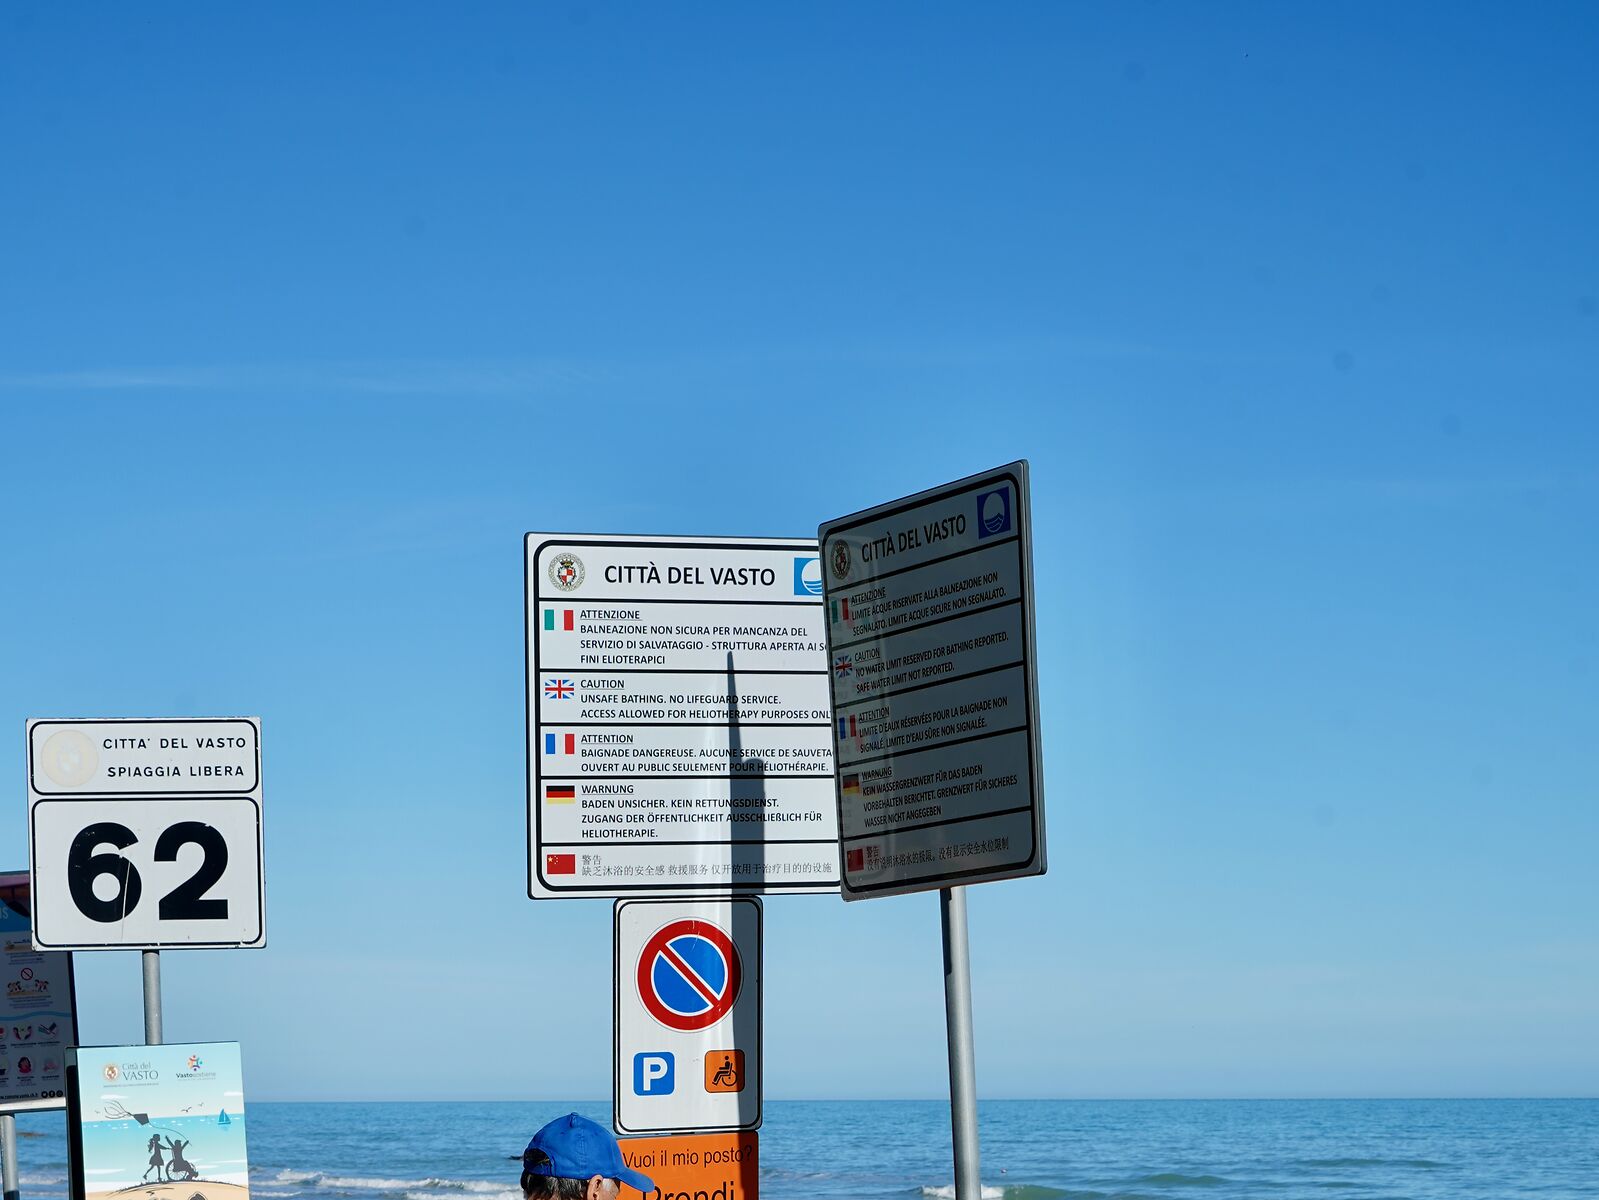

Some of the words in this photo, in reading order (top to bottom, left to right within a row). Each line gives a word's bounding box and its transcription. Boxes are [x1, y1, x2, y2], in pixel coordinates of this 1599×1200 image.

[861, 531, 896, 562] CITTÀ
[898, 524, 922, 553] DEL
[924, 514, 966, 545] VASTO
[604, 561, 661, 585] CITTÀ
[668, 567, 704, 585] DEL
[710, 567, 775, 586] VASTO
[851, 587, 886, 604] ATTENZIONE
[852, 607, 871, 620] LIMITE
[872, 601, 893, 615] ACQUE
[893, 593, 922, 609] RISERVATE
[924, 588, 939, 601] ALLA
[940, 576, 982, 597] BALNEAZIONE
[984, 571, 998, 583] NON
[580, 610, 640, 619] ATTENZIONE
[853, 619, 887, 636] SEGNALATO.
[889, 614, 907, 627] LIMITE
[909, 609, 929, 620] ACQUE
[930, 602, 951, 615] SICURE
[953, 598, 967, 609] NON
[968, 587, 1007, 606] SEGNALATO.
[580, 625, 647, 634] BALNEAZIONE
[651, 626, 673, 634] NON
[675, 626, 710, 635] SICURA
[713, 627, 730, 635] PER
[733, 627, 788, 636] MANCANZA
[791, 628, 807, 636] DEL
[580, 640, 623, 649] SERVIZIO
[627, 640, 636, 649] DI
[639, 641, 703, 650] SALVATAGGIO
[712, 641, 767, 650] STRUTTURA
[770, 642, 804, 651] APERTA
[807, 643, 816, 651] AI
[581, 655, 599, 663] FINI
[602, 655, 665, 664] ELIOTERAPICI
[855, 668, 865, 677] NO
[866, 662, 885, 676] WATER
[886, 658, 901, 670] LIMIT
[903, 650, 932, 666] RESERVED
[933, 647, 945, 659] FOR
[946, 640, 973, 655] BATHING
[974, 631, 1009, 648] REPORTED.
[855, 648, 880, 661] CAUTION
[856, 683, 871, 693] SAFE
[872, 678, 891, 690] WATER
[891, 673, 907, 685] LIMIT
[909, 670, 921, 681] NOT
[921, 662, 955, 677] REPORTED.
[581, 680, 624, 688] CAUTION
[581, 695, 618, 703] UNSAFE
[621, 695, 666, 703] BATHING.
[670, 695, 684, 703] NO
[687, 695, 738, 704] LIFEGUARD
[741, 695, 781, 704] SERVICE.
[581, 710, 616, 718] ACCESS
[619, 710, 665, 718] ALLOWED
[668, 710, 686, 718] FOR
[689, 710, 758, 719] HELIOTHERAPY
[761, 710, 809, 719] PURPOSES
[811, 711, 831, 719] ONL
[859, 706, 890, 721] ATTENTION
[859, 725, 879, 738] LIMITE
[933, 709, 950, 722] POUR
[960, 699, 991, 715] BAIGNADE
[993, 696, 1008, 707] NON
[581, 735, 633, 743] ATTENTION
[886, 736, 905, 747] LIMITE
[941, 725, 955, 736] NON
[160, 738, 188, 749] DEL
[196, 737, 246, 748] VASTO
[581, 749, 629, 757] BAIGNADE
[632, 749, 696, 757] DANGEREUSE.
[699, 749, 737, 758] AUCUNE
[740, 749, 775, 757] SERVICE
[779, 749, 790, 757] DE
[107, 767, 181, 777] SPIAGGIA
[190, 766, 244, 776] LIBERA
[672, 763, 727, 772] SEULEMENT
[730, 763, 754, 771] POUR
[757, 761, 828, 771] HÉLIOTHÉRAPIE.
[862, 767, 892, 780] WARNUNG
[862, 786, 875, 796] KEIN
[876, 774, 934, 794] WASSERGRENZWERT
[948, 769, 960, 780] DAS
[961, 765, 983, 777] BADEN
[582, 785, 634, 793] WARNUNG
[582, 800, 615, 808] BADEN
[618, 800, 668, 808] UNSICHER.
[671, 800, 692, 808] KEIN
[695, 798, 779, 808] RETTUNGSDIENST.
[582, 815, 623, 823] ZUGANG
[626, 814, 645, 823] DER
[647, 812, 724, 823] ÖFFENTLICHKEIT
[805, 811, 822, 821] FÜR
[865, 816, 887, 828] WASSER
[888, 812, 905, 823] NICHT
[906, 806, 941, 819] ANGEGEBEN
[582, 829, 658, 838] HELIOTHERAPIE.
[582, 855, 601, 865] 警告
[67, 821, 229, 923] 62
[122, 1070, 159, 1081] VASTO
[643, 1057, 668, 1091] P
[623, 1151, 655, 1168] Vuoi
[661, 1150, 667, 1166] il
[673, 1148, 699, 1166] mio
[704, 1145, 752, 1168] posto?
